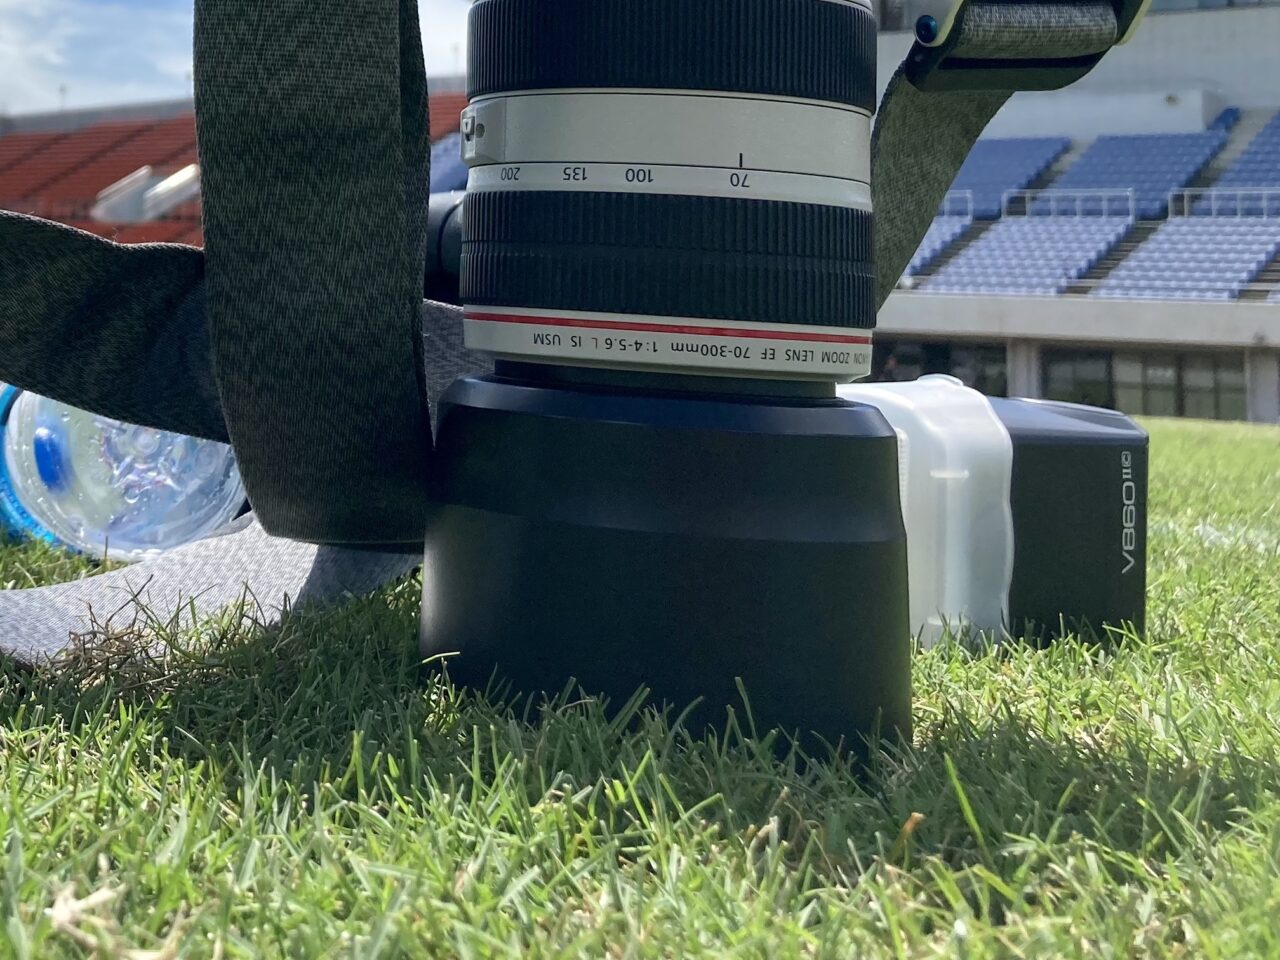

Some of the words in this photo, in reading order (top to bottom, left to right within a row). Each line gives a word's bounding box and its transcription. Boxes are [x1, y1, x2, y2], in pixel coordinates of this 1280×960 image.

[500, 167, 520, 181] 200
[563, 167, 588, 181] 135
[625, 168, 654, 183] 100
[729, 172, 751, 188] 70
[533, 332, 561, 346] USM
[570, 335, 582, 348] IS
[591, 337, 598, 349] L
[605, 337, 659, 353] 1:4-5.6
[670, 341, 751, 360] 70-300mm
[760, 348, 776, 360] EF
[785, 349, 814, 362] LENS
[821, 351, 850, 364] ZOOM
